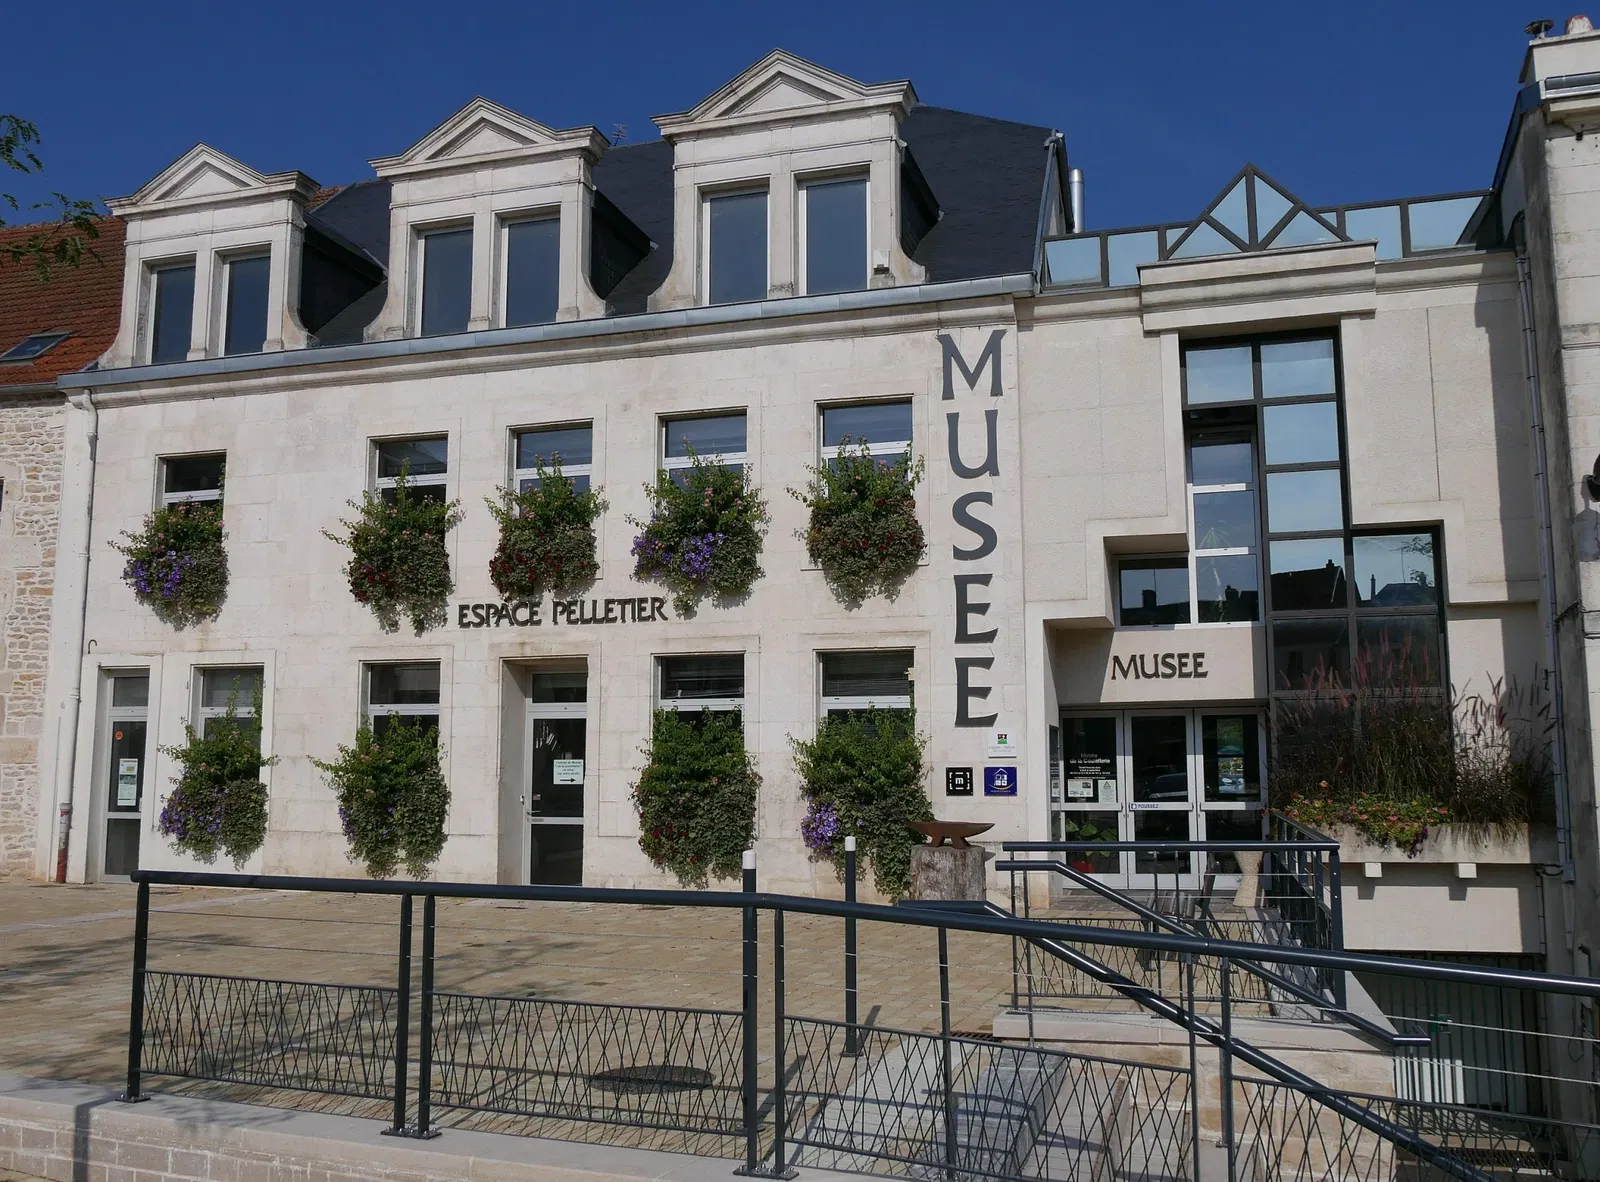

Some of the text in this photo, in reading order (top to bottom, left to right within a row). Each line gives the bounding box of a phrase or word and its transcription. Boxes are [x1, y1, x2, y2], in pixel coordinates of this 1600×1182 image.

[936, 329, 1008, 728] MUSEE
[458, 597, 668, 628] ESPACE PELLETIER
[1111, 652, 1209, 680] MUSEE
